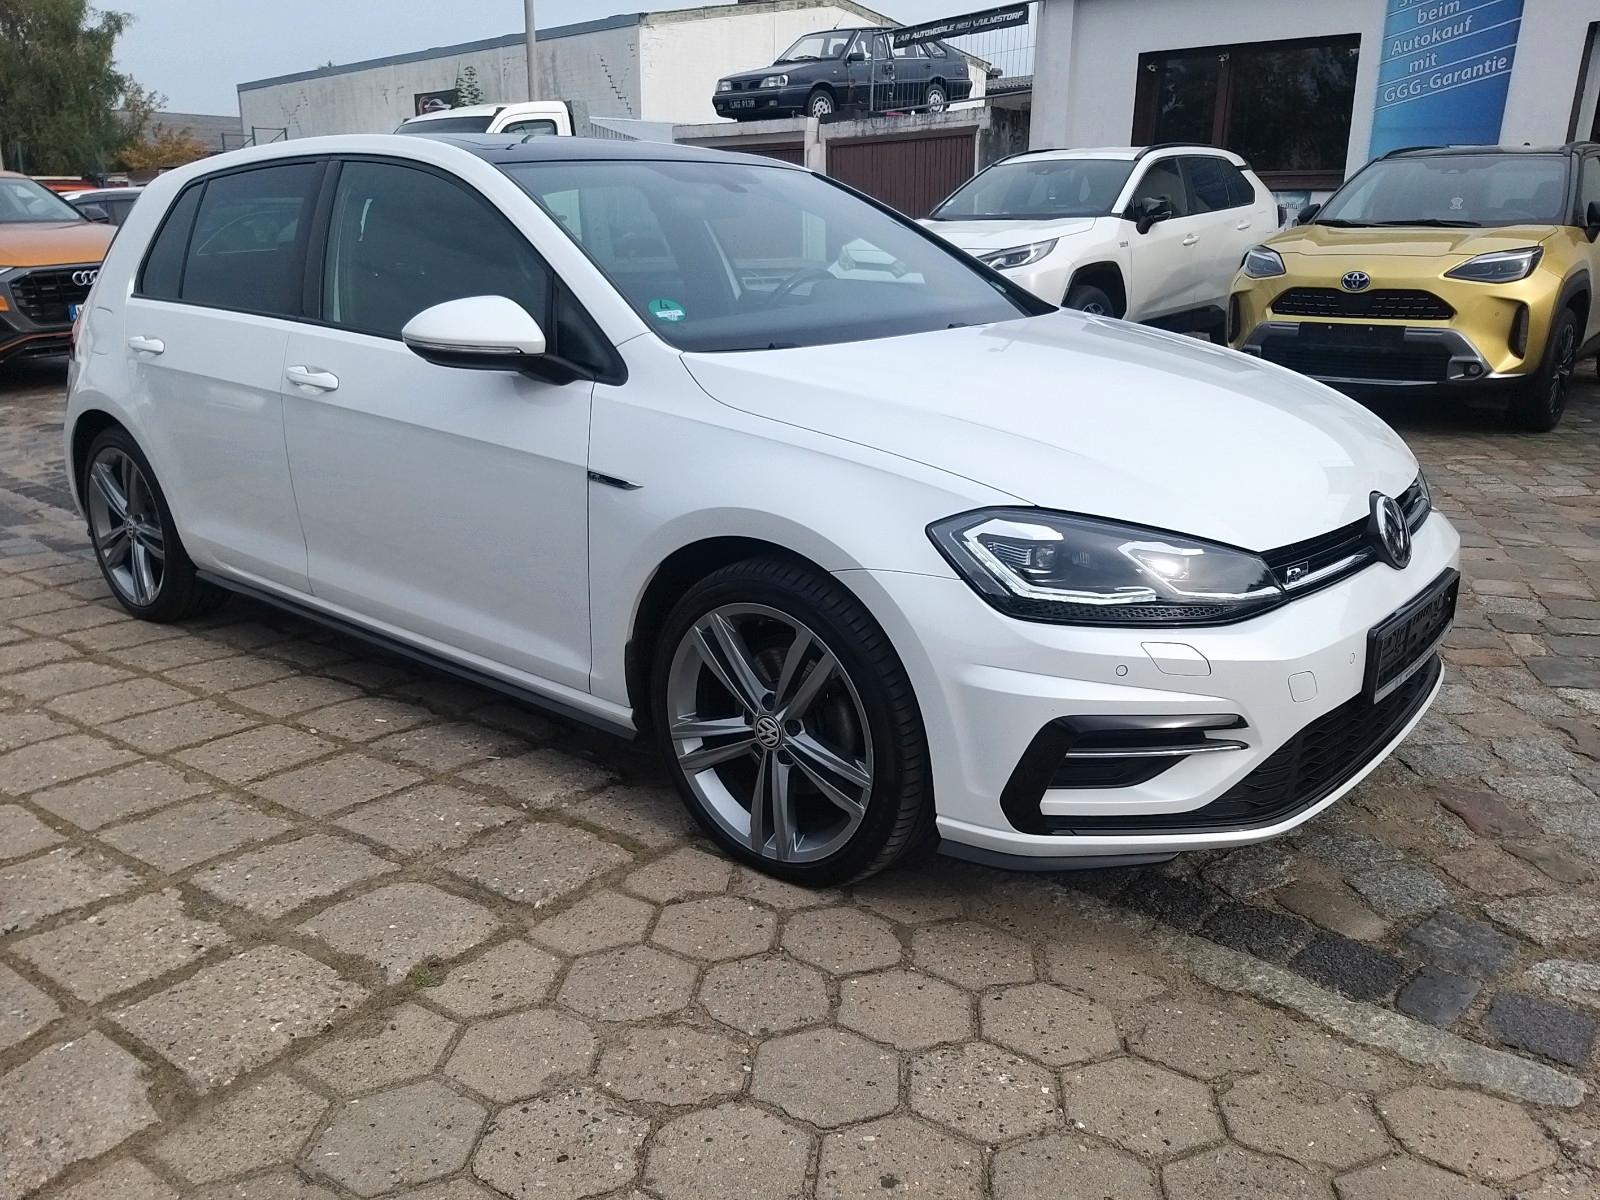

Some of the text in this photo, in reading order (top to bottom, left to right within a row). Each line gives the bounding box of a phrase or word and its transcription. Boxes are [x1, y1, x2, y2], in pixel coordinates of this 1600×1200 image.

[895, 11, 1025, 42] CAR AUTOMOBILE NEU WULMSTORF
[1417, 1, 1460, 24] beim
[1391, 15, 1473, 56] Autokauf
[1408, 53, 1437, 73] mit
[1384, 56, 1508, 102] GGG-Garantie
